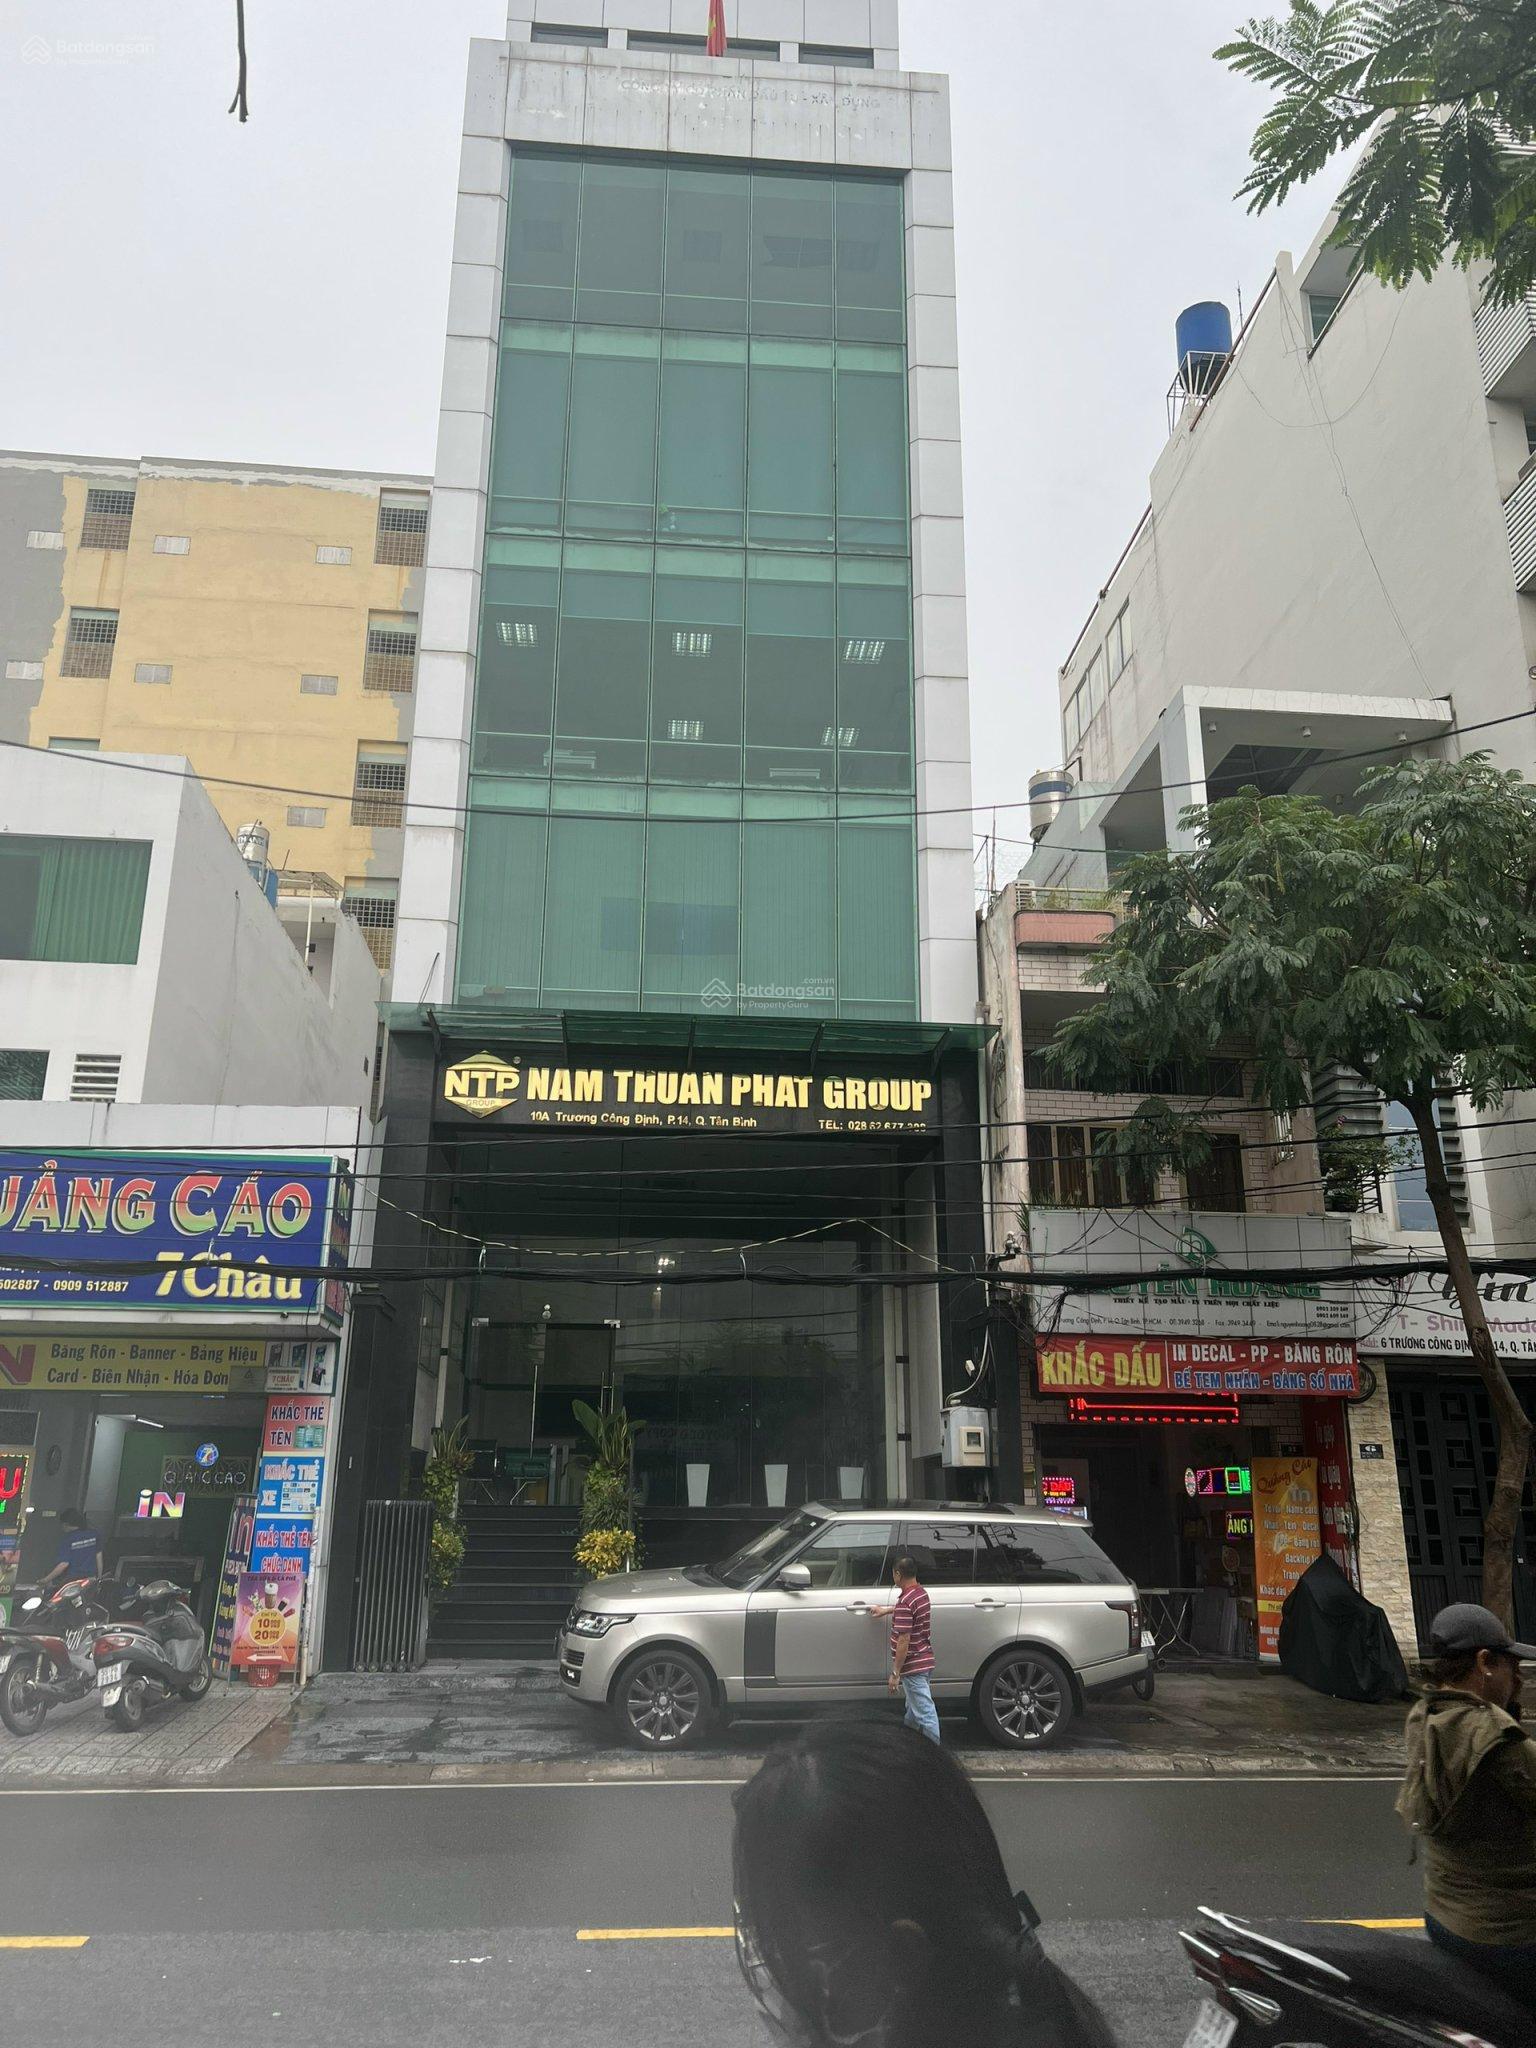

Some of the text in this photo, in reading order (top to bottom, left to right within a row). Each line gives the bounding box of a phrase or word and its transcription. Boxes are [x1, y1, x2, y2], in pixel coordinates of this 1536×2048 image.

[444, 1070, 520, 1098] NTP
[526, 1067, 603, 1102] NAM
[823, 1077, 933, 1113] GROUP
[530, 1111, 550, 1121] 10A
[555, 1111, 598, 1125] Trương
[601, 1111, 630, 1125] Công
[635, 1113, 663, 1126] Định,
[709, 1116, 729, 1127] Tân
[733, 1115, 757, 1127] Bình
[818, 1120, 843, 1130] TEL:
[848, 1121, 867, 1131] 028
[53, 1280, 82, 1292] 0909
[86, 1280, 129, 1292] 512887
[89, 1342, 116, 1360] Rôn
[129, 1344, 176, 1361] Banner
[190, 1343, 225, 1363] Bảng
[228, 1344, 259, 1363] Hiệu
[1172, 1343, 1353, 1364] IN DECAL PP BĂNG RÔN
[1381, 1338, 1387, 1348] 6
[1389, 1337, 1426, 1350] TRƯƠNG
[1428, 1336, 1453, 1350] CÔNG
[1455, 1340, 1471, 1353] ĐỊN
[1510, 1342, 1520, 1353] Q.
[1041, 1340, 1161, 1387] KHẮC DẤU
[47, 1368, 229, 1387] Card Biên Nhận Hóa Đơn
[1194, 1371, 1222, 1389] TEM
[1329, 1369, 1355, 1391] NHÀ
[271, 1400, 325, 1420] KHẮC THẺ
[270, 1428, 292, 1446] TÊN
[264, 1458, 320, 1481] KHẮC THẺ
[261, 1490, 277, 1506] XE
[255, 1524, 279, 1547] KHẮC
[279, 1525, 296, 1548] THẺ
[283, 1557, 304, 1572] DANH
